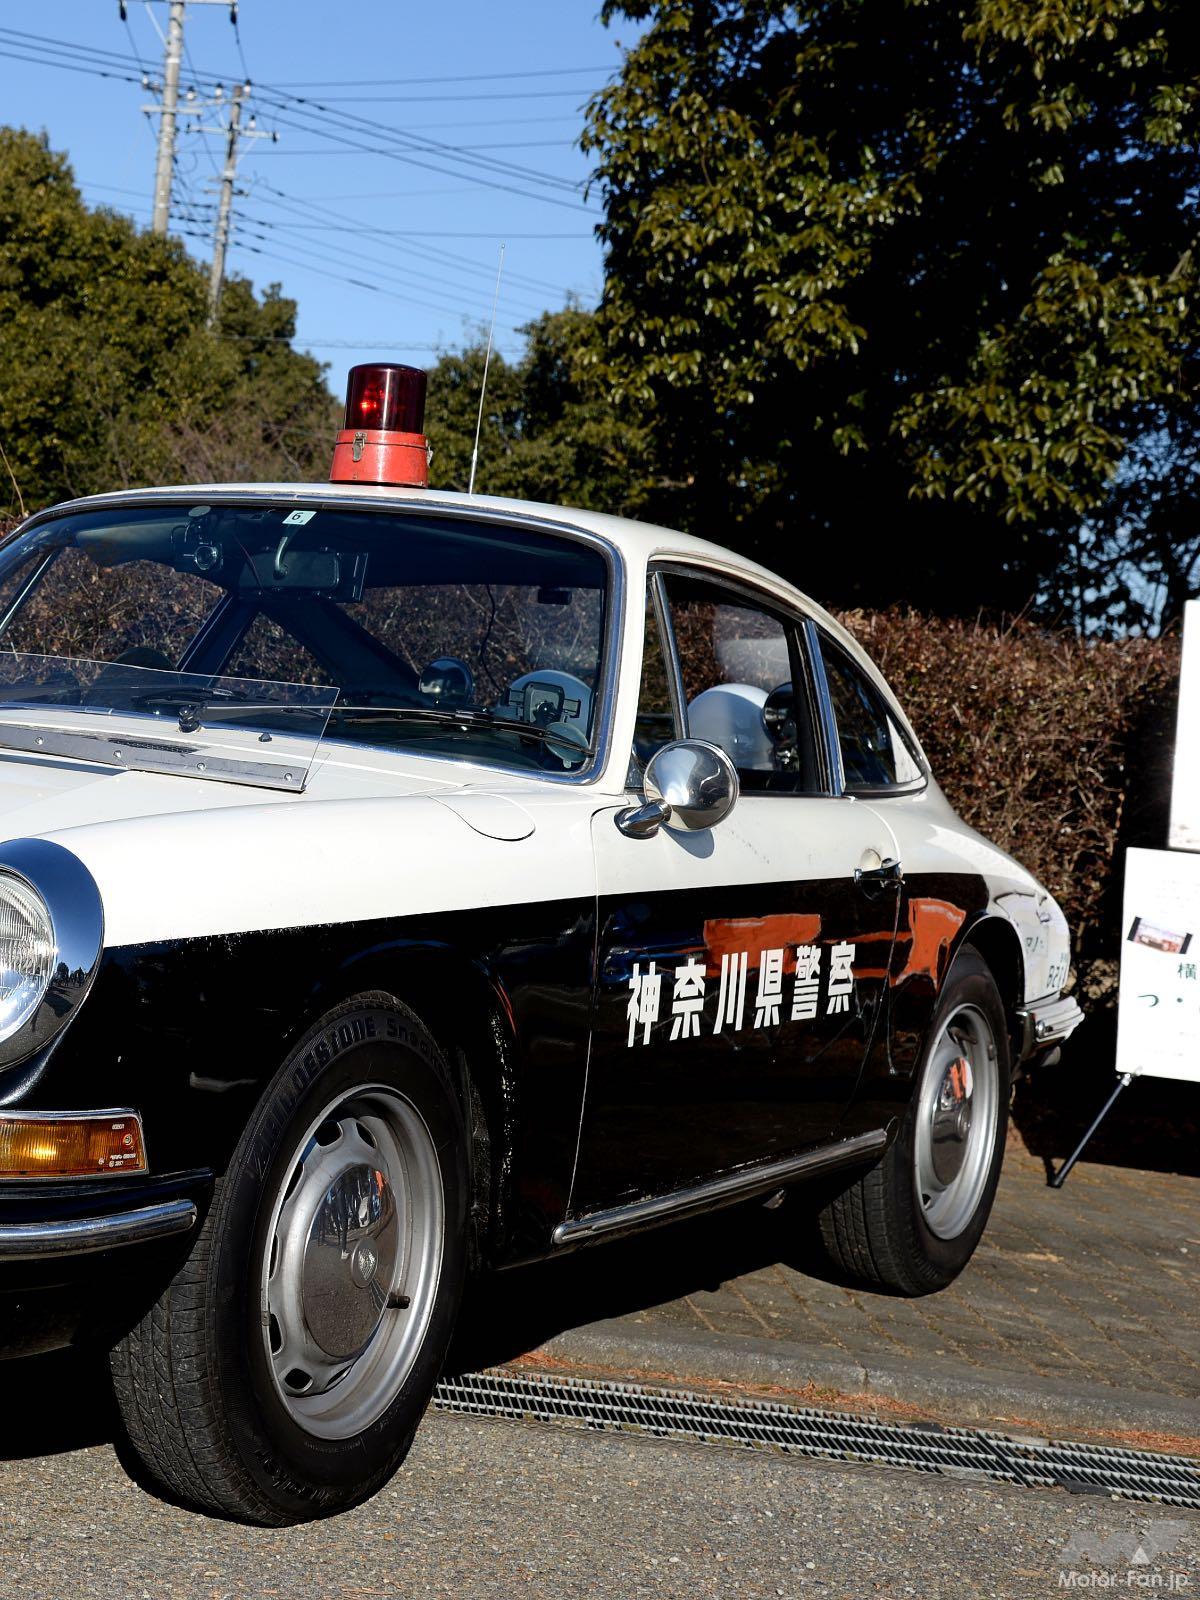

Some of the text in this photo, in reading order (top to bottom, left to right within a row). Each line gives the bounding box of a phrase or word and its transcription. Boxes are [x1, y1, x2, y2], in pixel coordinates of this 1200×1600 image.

[626, 940, 856, 1048] 神奈川県警察
[1177, 962, 1197, 981] 横
